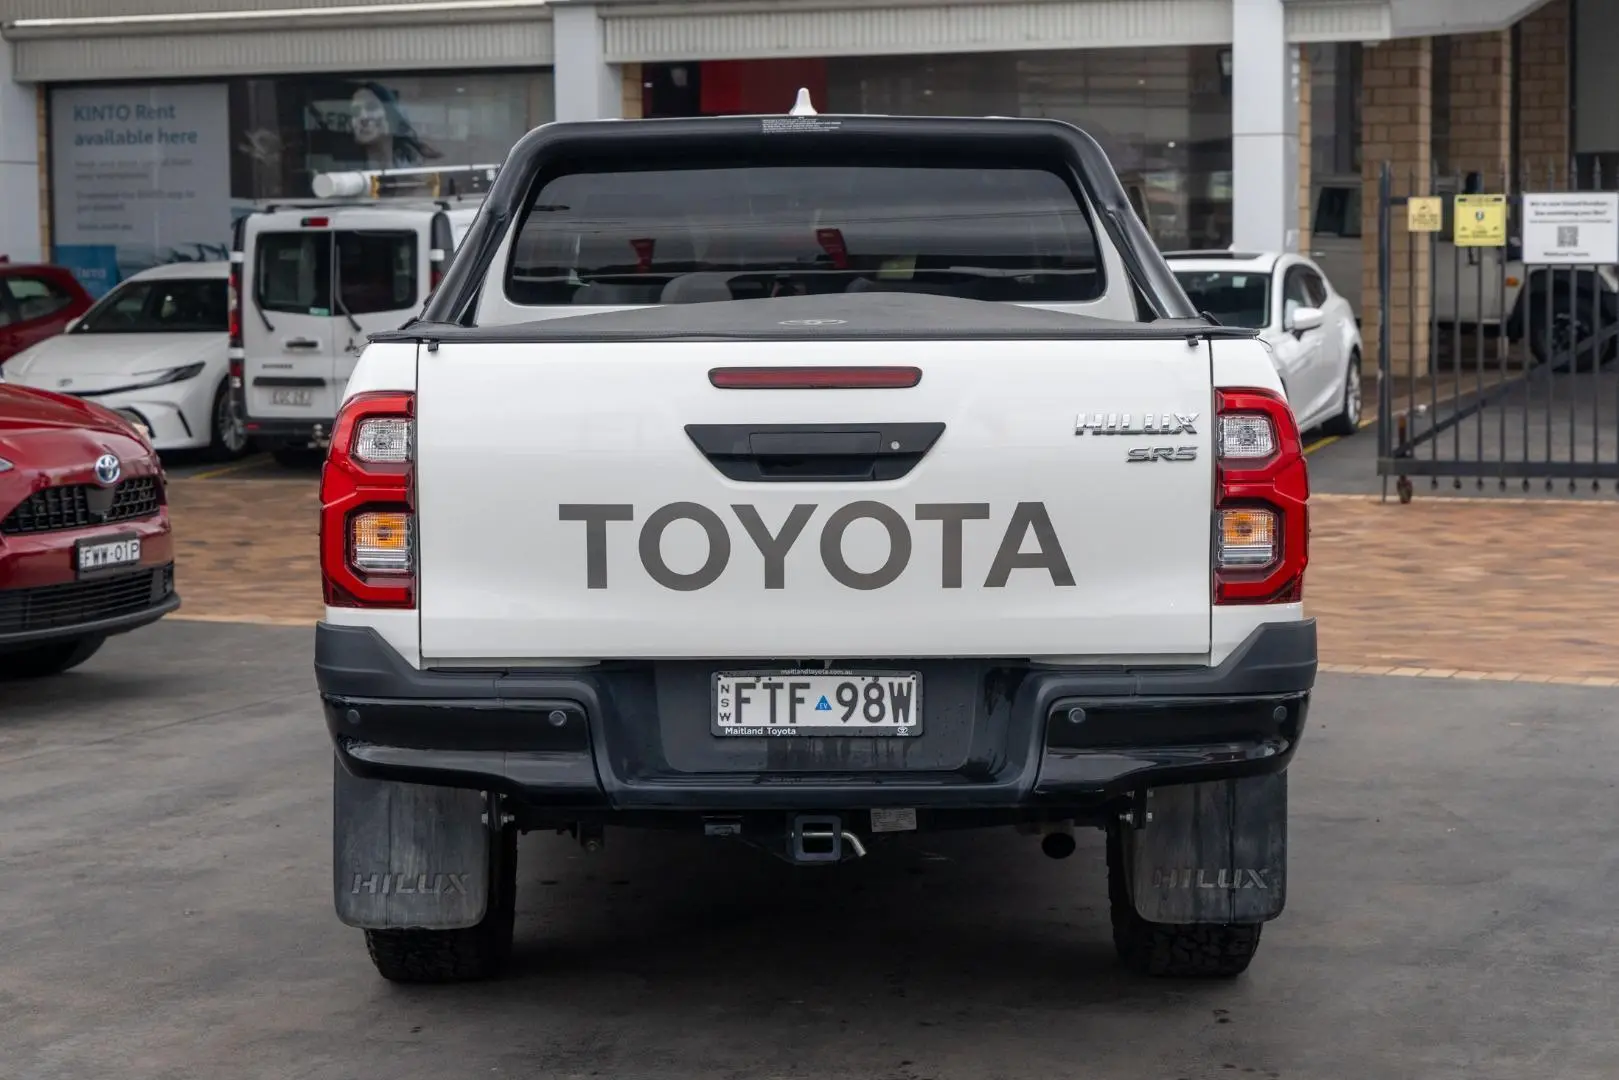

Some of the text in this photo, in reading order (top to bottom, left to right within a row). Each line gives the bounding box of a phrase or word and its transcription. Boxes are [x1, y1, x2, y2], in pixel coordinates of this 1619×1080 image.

[73, 104, 176, 121] KINTO Rent
[74, 128, 198, 146] available here
[1075, 413, 1199, 435] HILUX
[1126, 446, 1198, 462] SR5
[559, 500, 1077, 592] TOYOTA
[720, 684, 732, 722] NSW
[734, 682, 811, 724] FTF
[835, 681, 913, 724] 98W
[725, 727, 797, 736] Maitland Toyota
[352, 873, 471, 895] HILUX
[1153, 868, 1269, 889] HILUX
